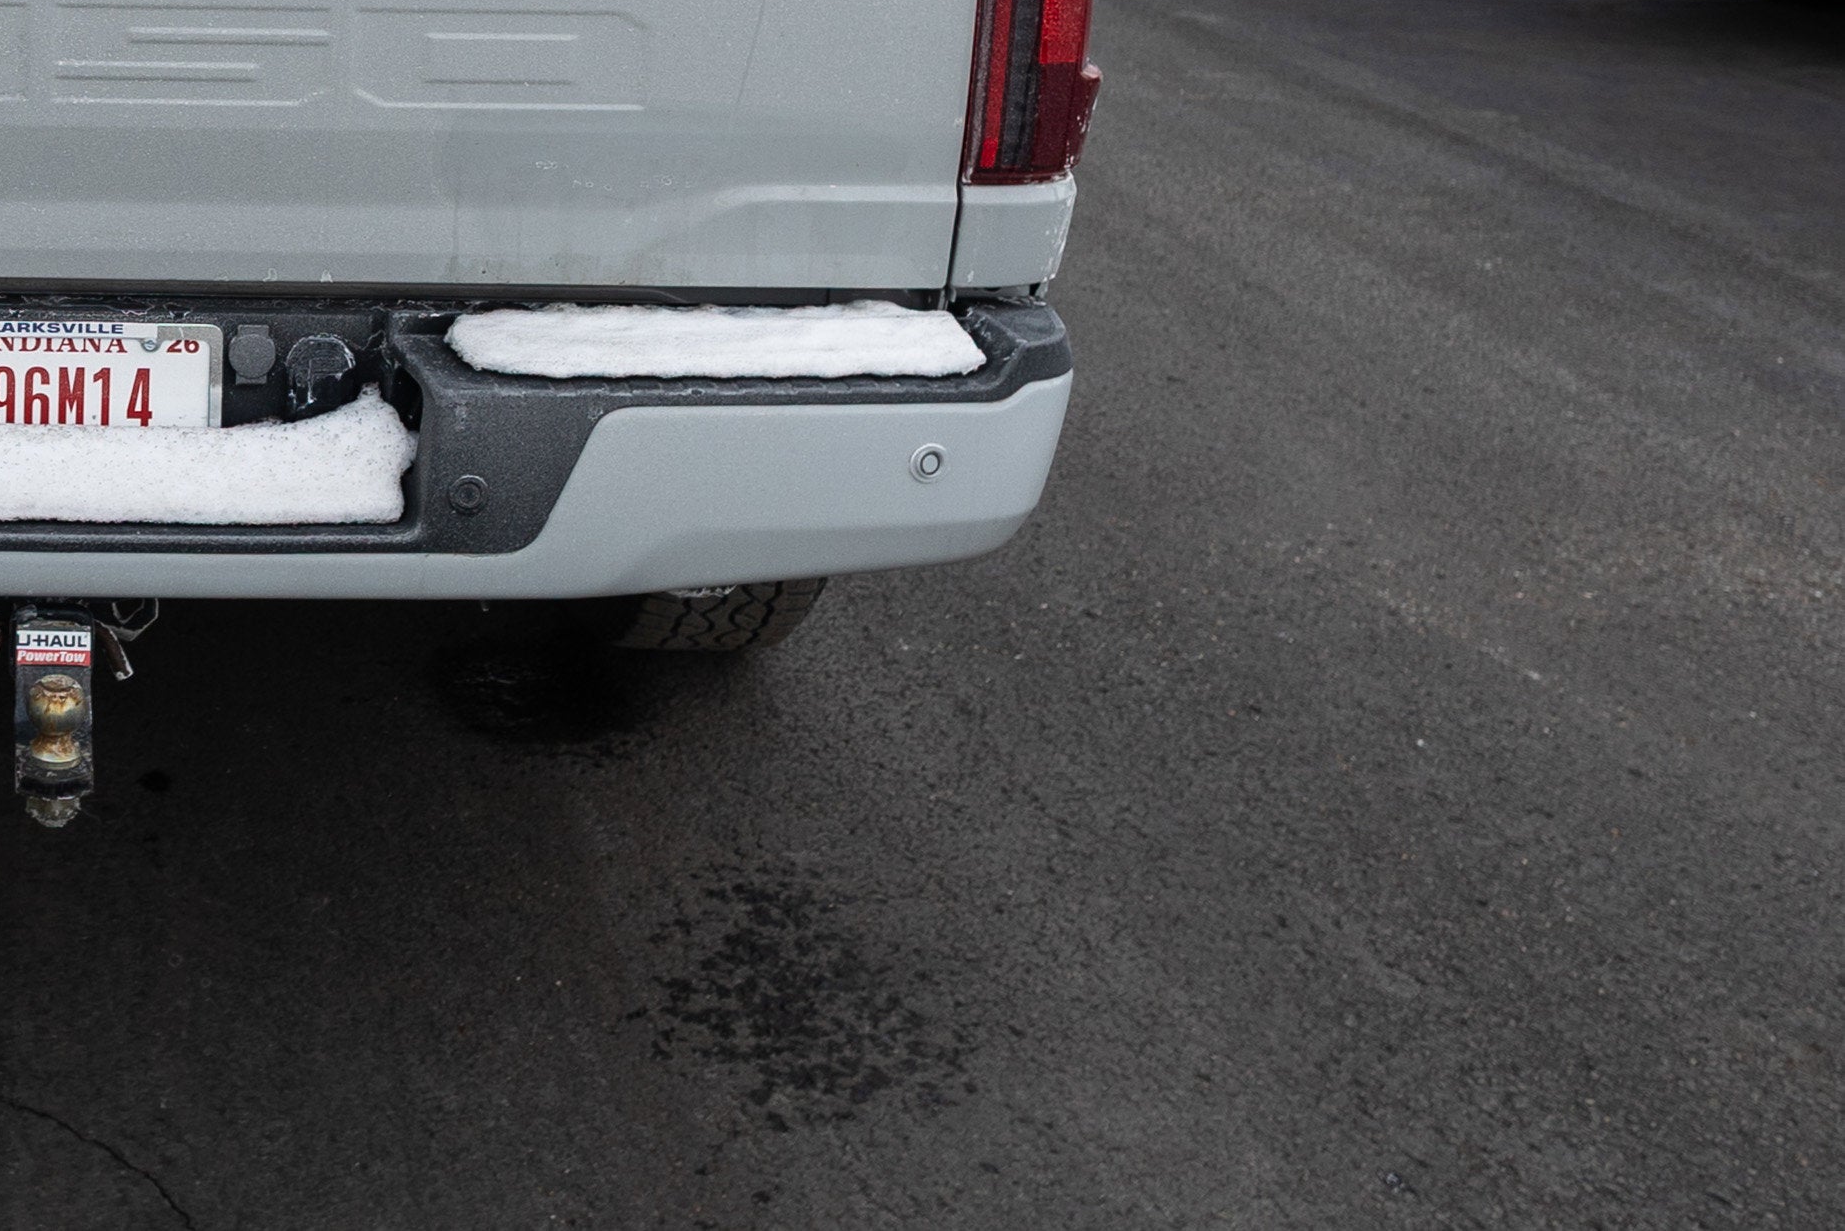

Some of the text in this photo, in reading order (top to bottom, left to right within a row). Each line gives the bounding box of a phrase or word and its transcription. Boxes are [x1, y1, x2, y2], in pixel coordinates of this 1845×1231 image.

[166, 337, 200, 354] 26
[17, 634, 88, 647] U-HAUL
[17, 650, 86, 663] PowerTow
